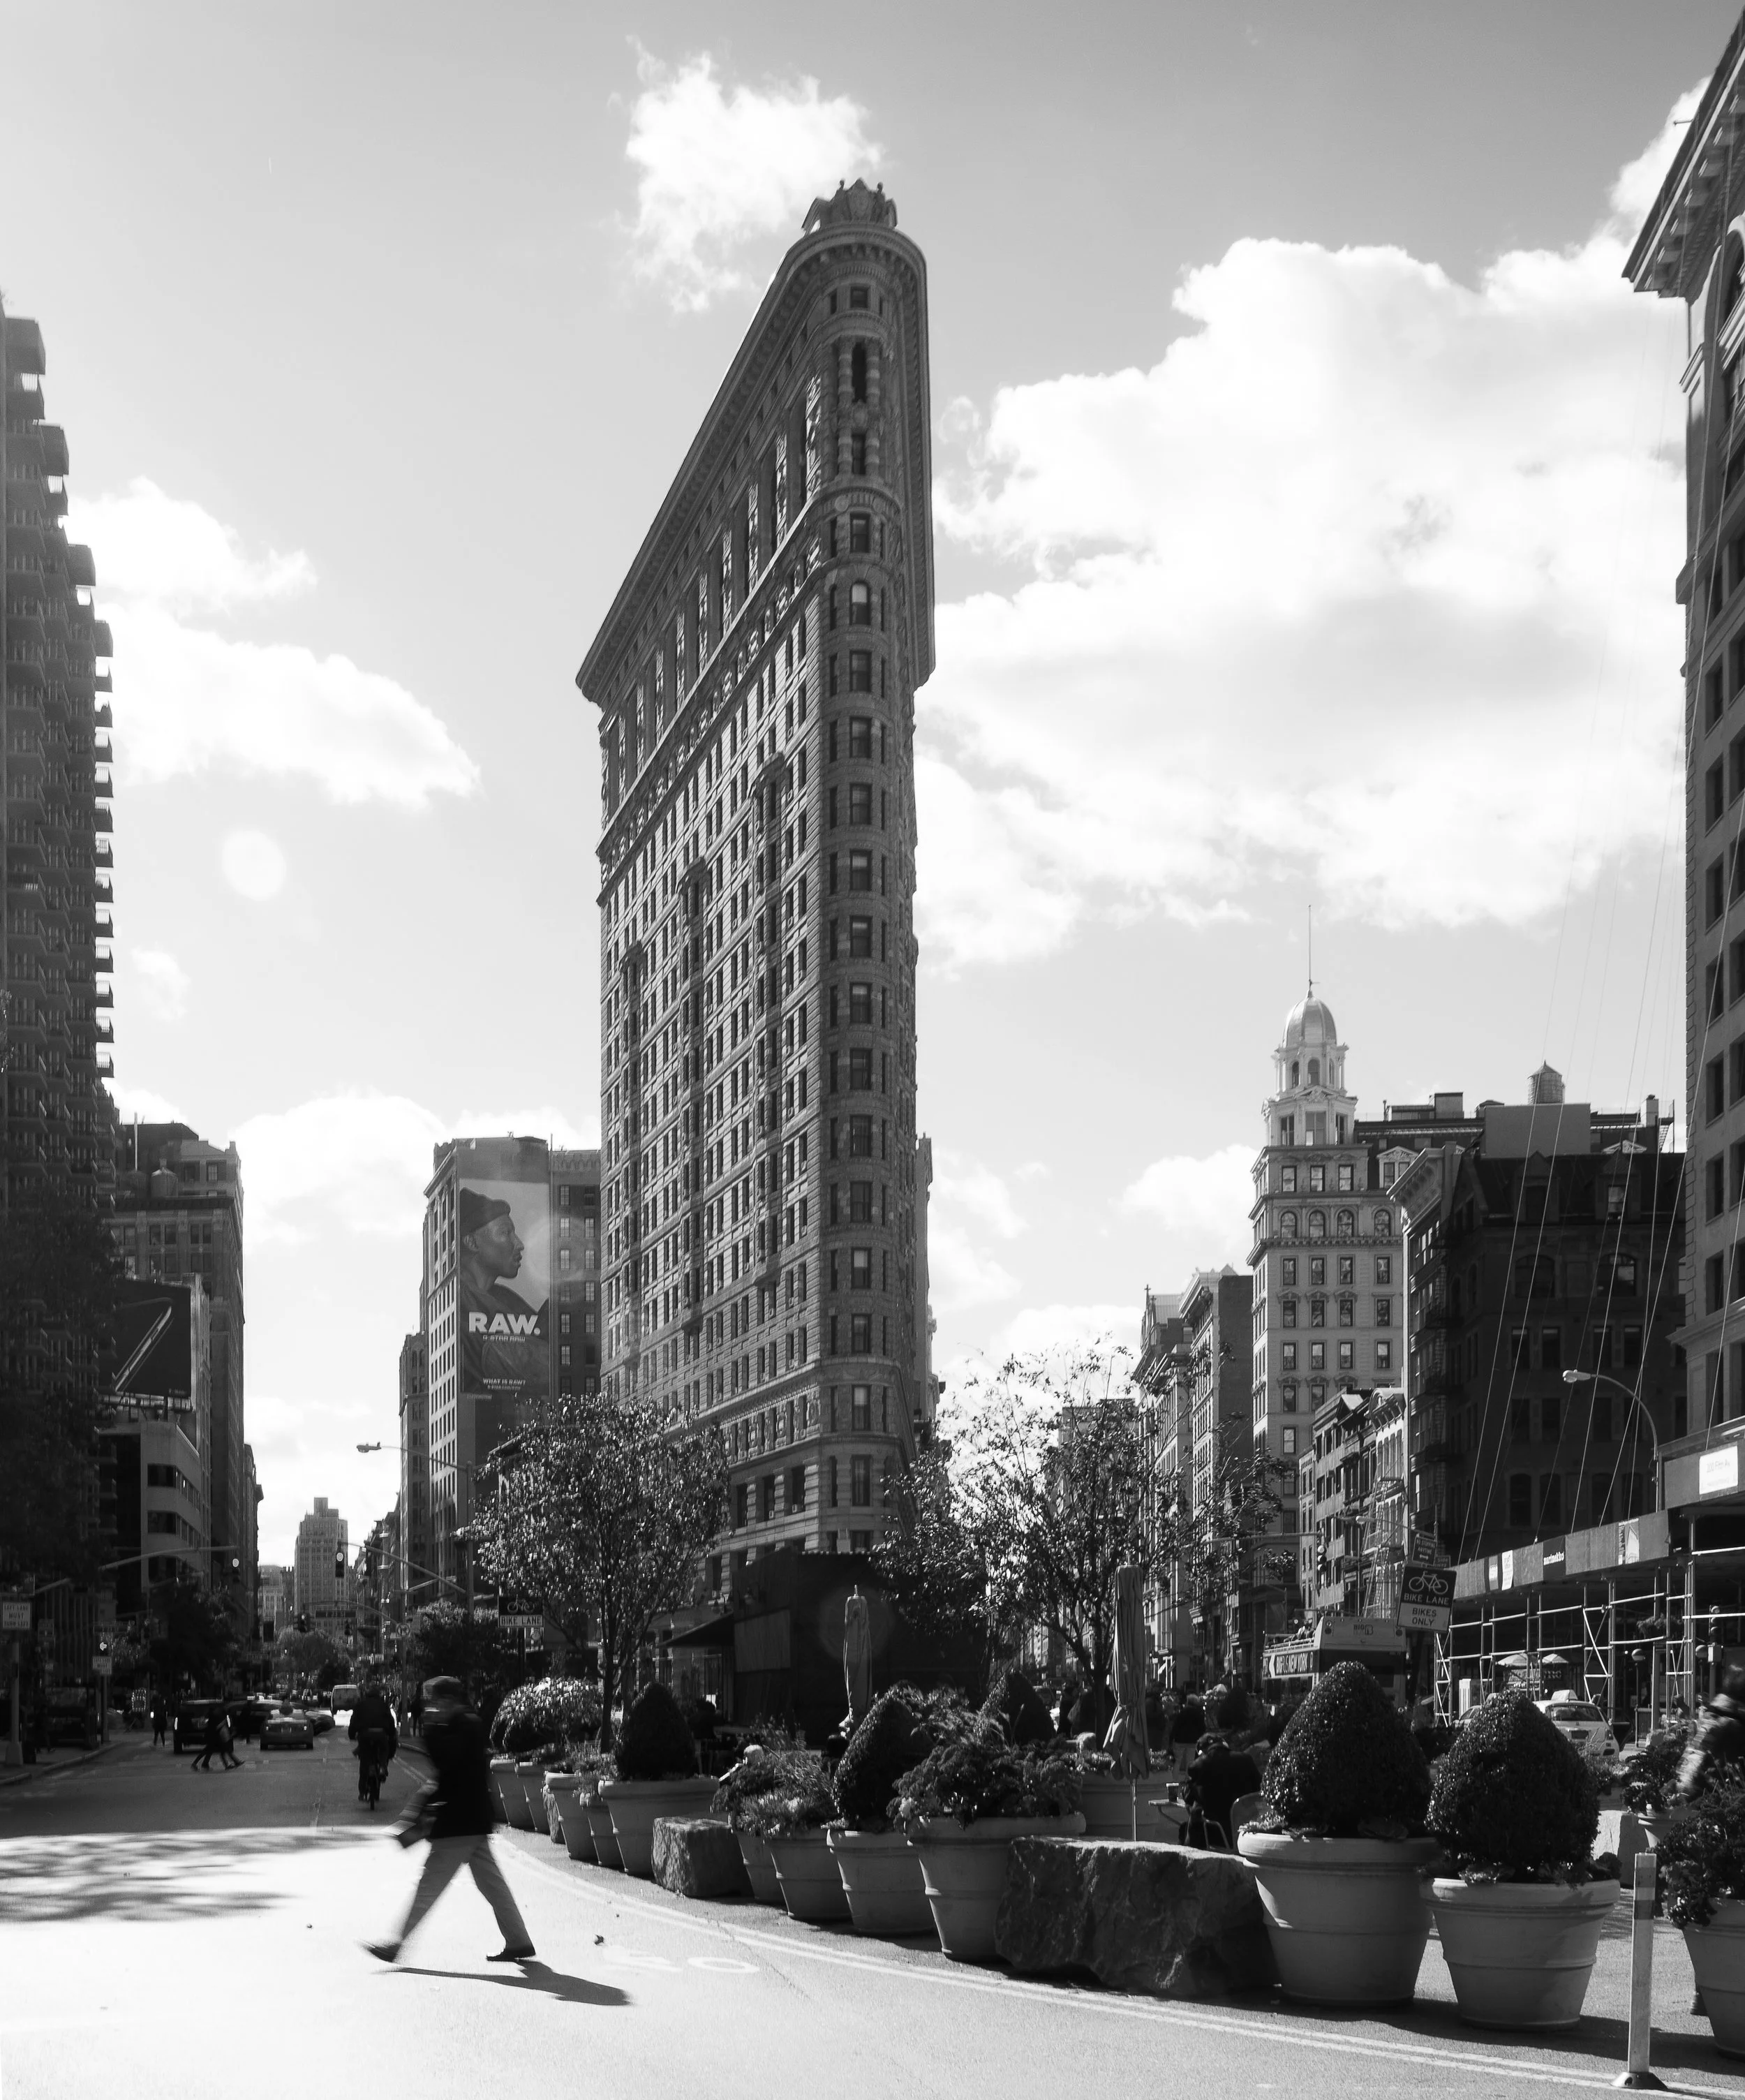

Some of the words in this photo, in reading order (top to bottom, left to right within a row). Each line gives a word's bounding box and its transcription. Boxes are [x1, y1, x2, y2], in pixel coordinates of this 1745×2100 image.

[468, 1311, 541, 1336] RAW.
[1404, 1592, 1423, 1603] BIKE
[1426, 1596, 1450, 1605] LANE
[1412, 1607, 1436, 1618] BIKES
[501, 1616, 518, 1625] BIKE
[521, 1616, 541, 1625] LANE
[1412, 1617, 1435, 1626] ONLY
